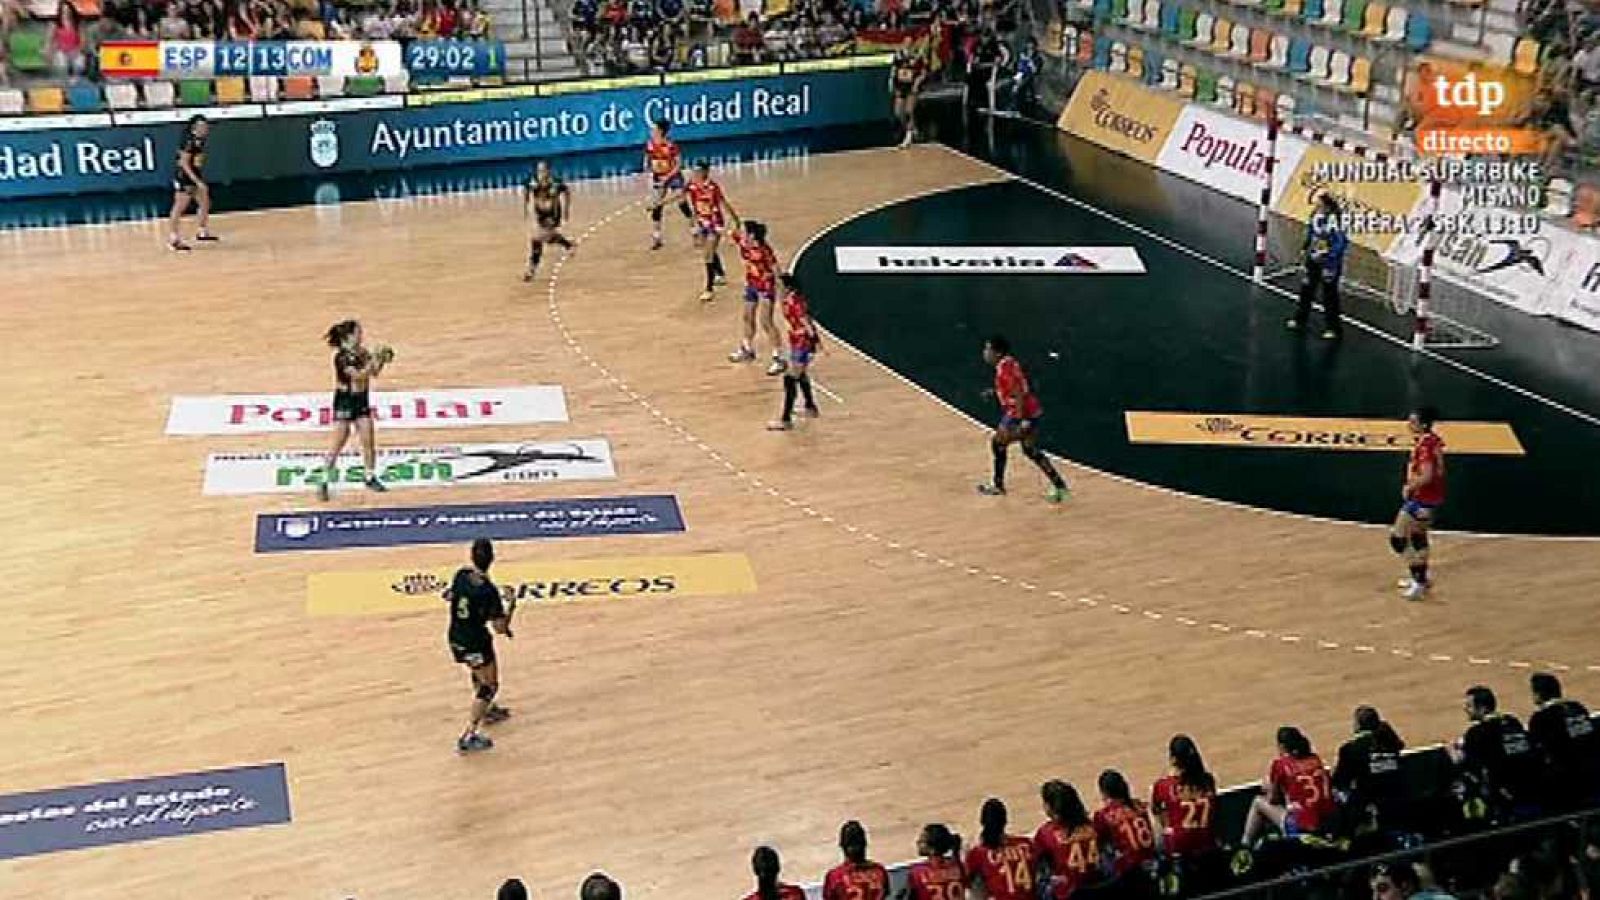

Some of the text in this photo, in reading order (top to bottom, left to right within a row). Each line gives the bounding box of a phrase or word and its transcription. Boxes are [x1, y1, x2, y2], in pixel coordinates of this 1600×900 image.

[371, 85, 811, 156] Ayuntamiento de Ciudad Real
[76, 136, 155, 174] Real
[1180, 119, 1269, 181] Popula
[878, 254, 1047, 267] helvetia
[1240, 426, 1418, 446] CORREO
[83, 796, 128, 813] del
[135, 785, 232, 806] Estado
[1179, 797, 1210, 829] 27
[1120, 816, 1153, 850] 18
[1067, 839, 1100, 873] 44
[998, 859, 1033, 893] 14
